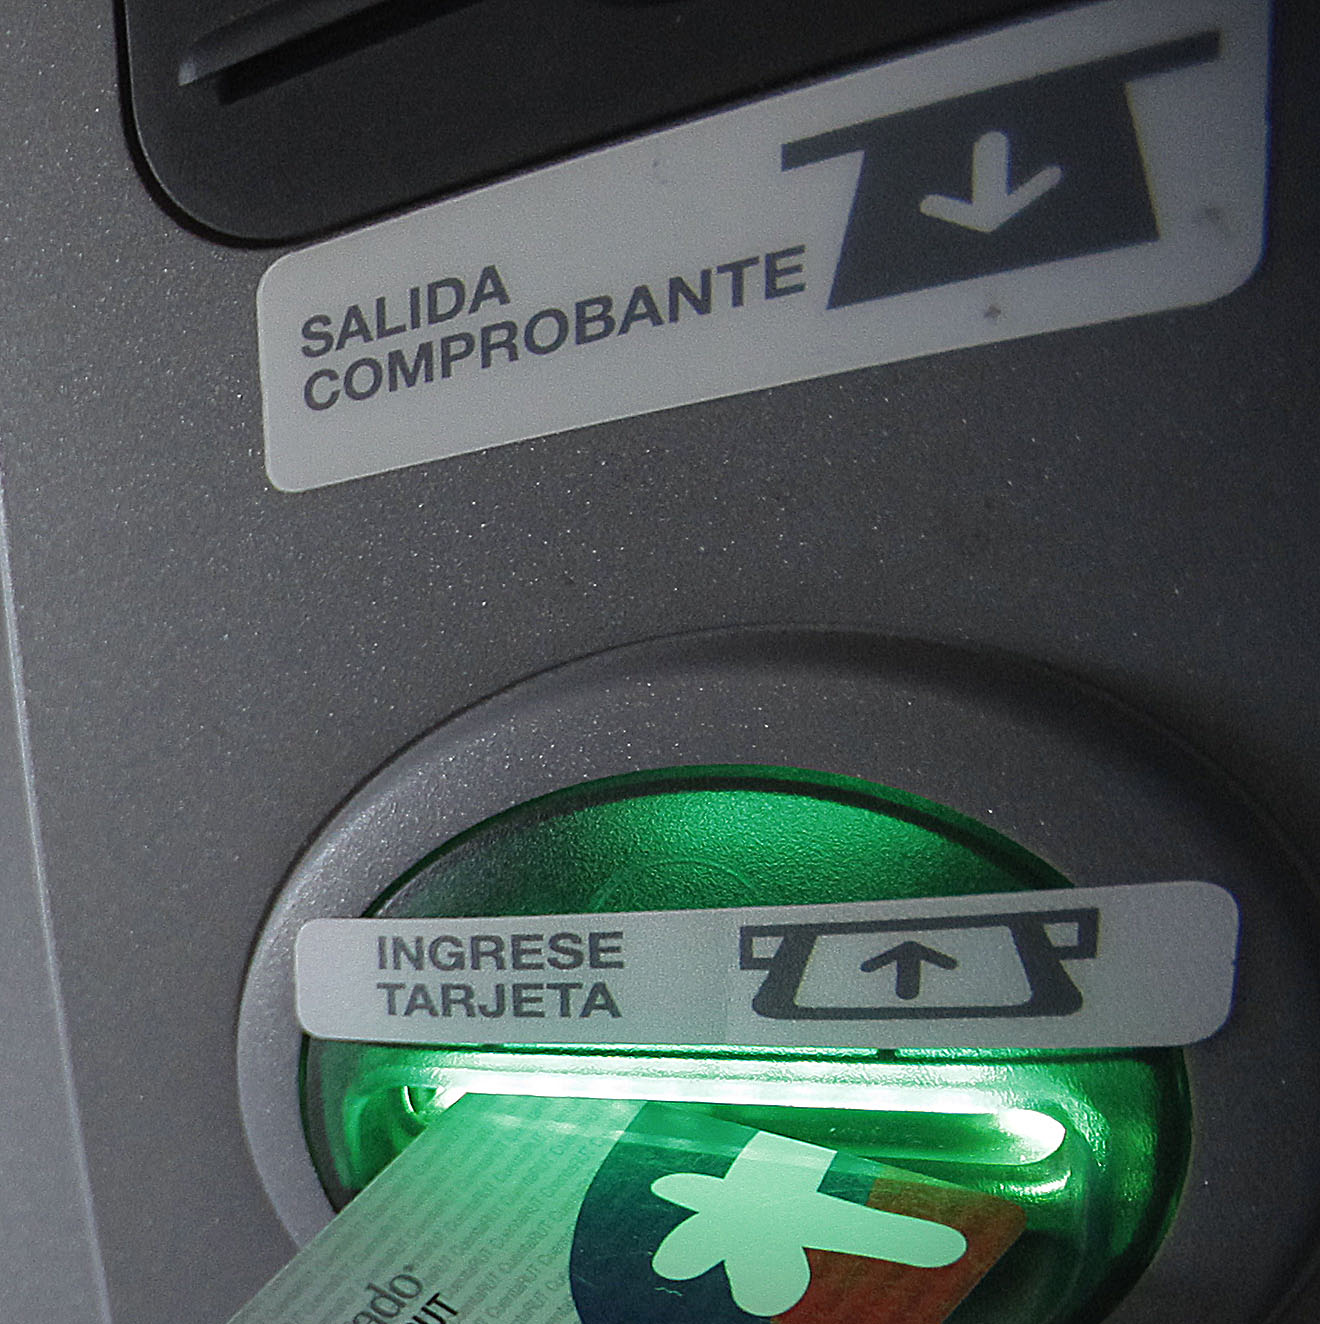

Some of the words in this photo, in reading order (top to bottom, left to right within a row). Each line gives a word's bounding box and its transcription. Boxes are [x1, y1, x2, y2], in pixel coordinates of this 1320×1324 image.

[299, 263, 513, 361] SALIDA
[302, 245, 808, 413] COMPROBANTE
[377, 931, 624, 971] INGRESE
[377, 982, 622, 1020] TARJETA
